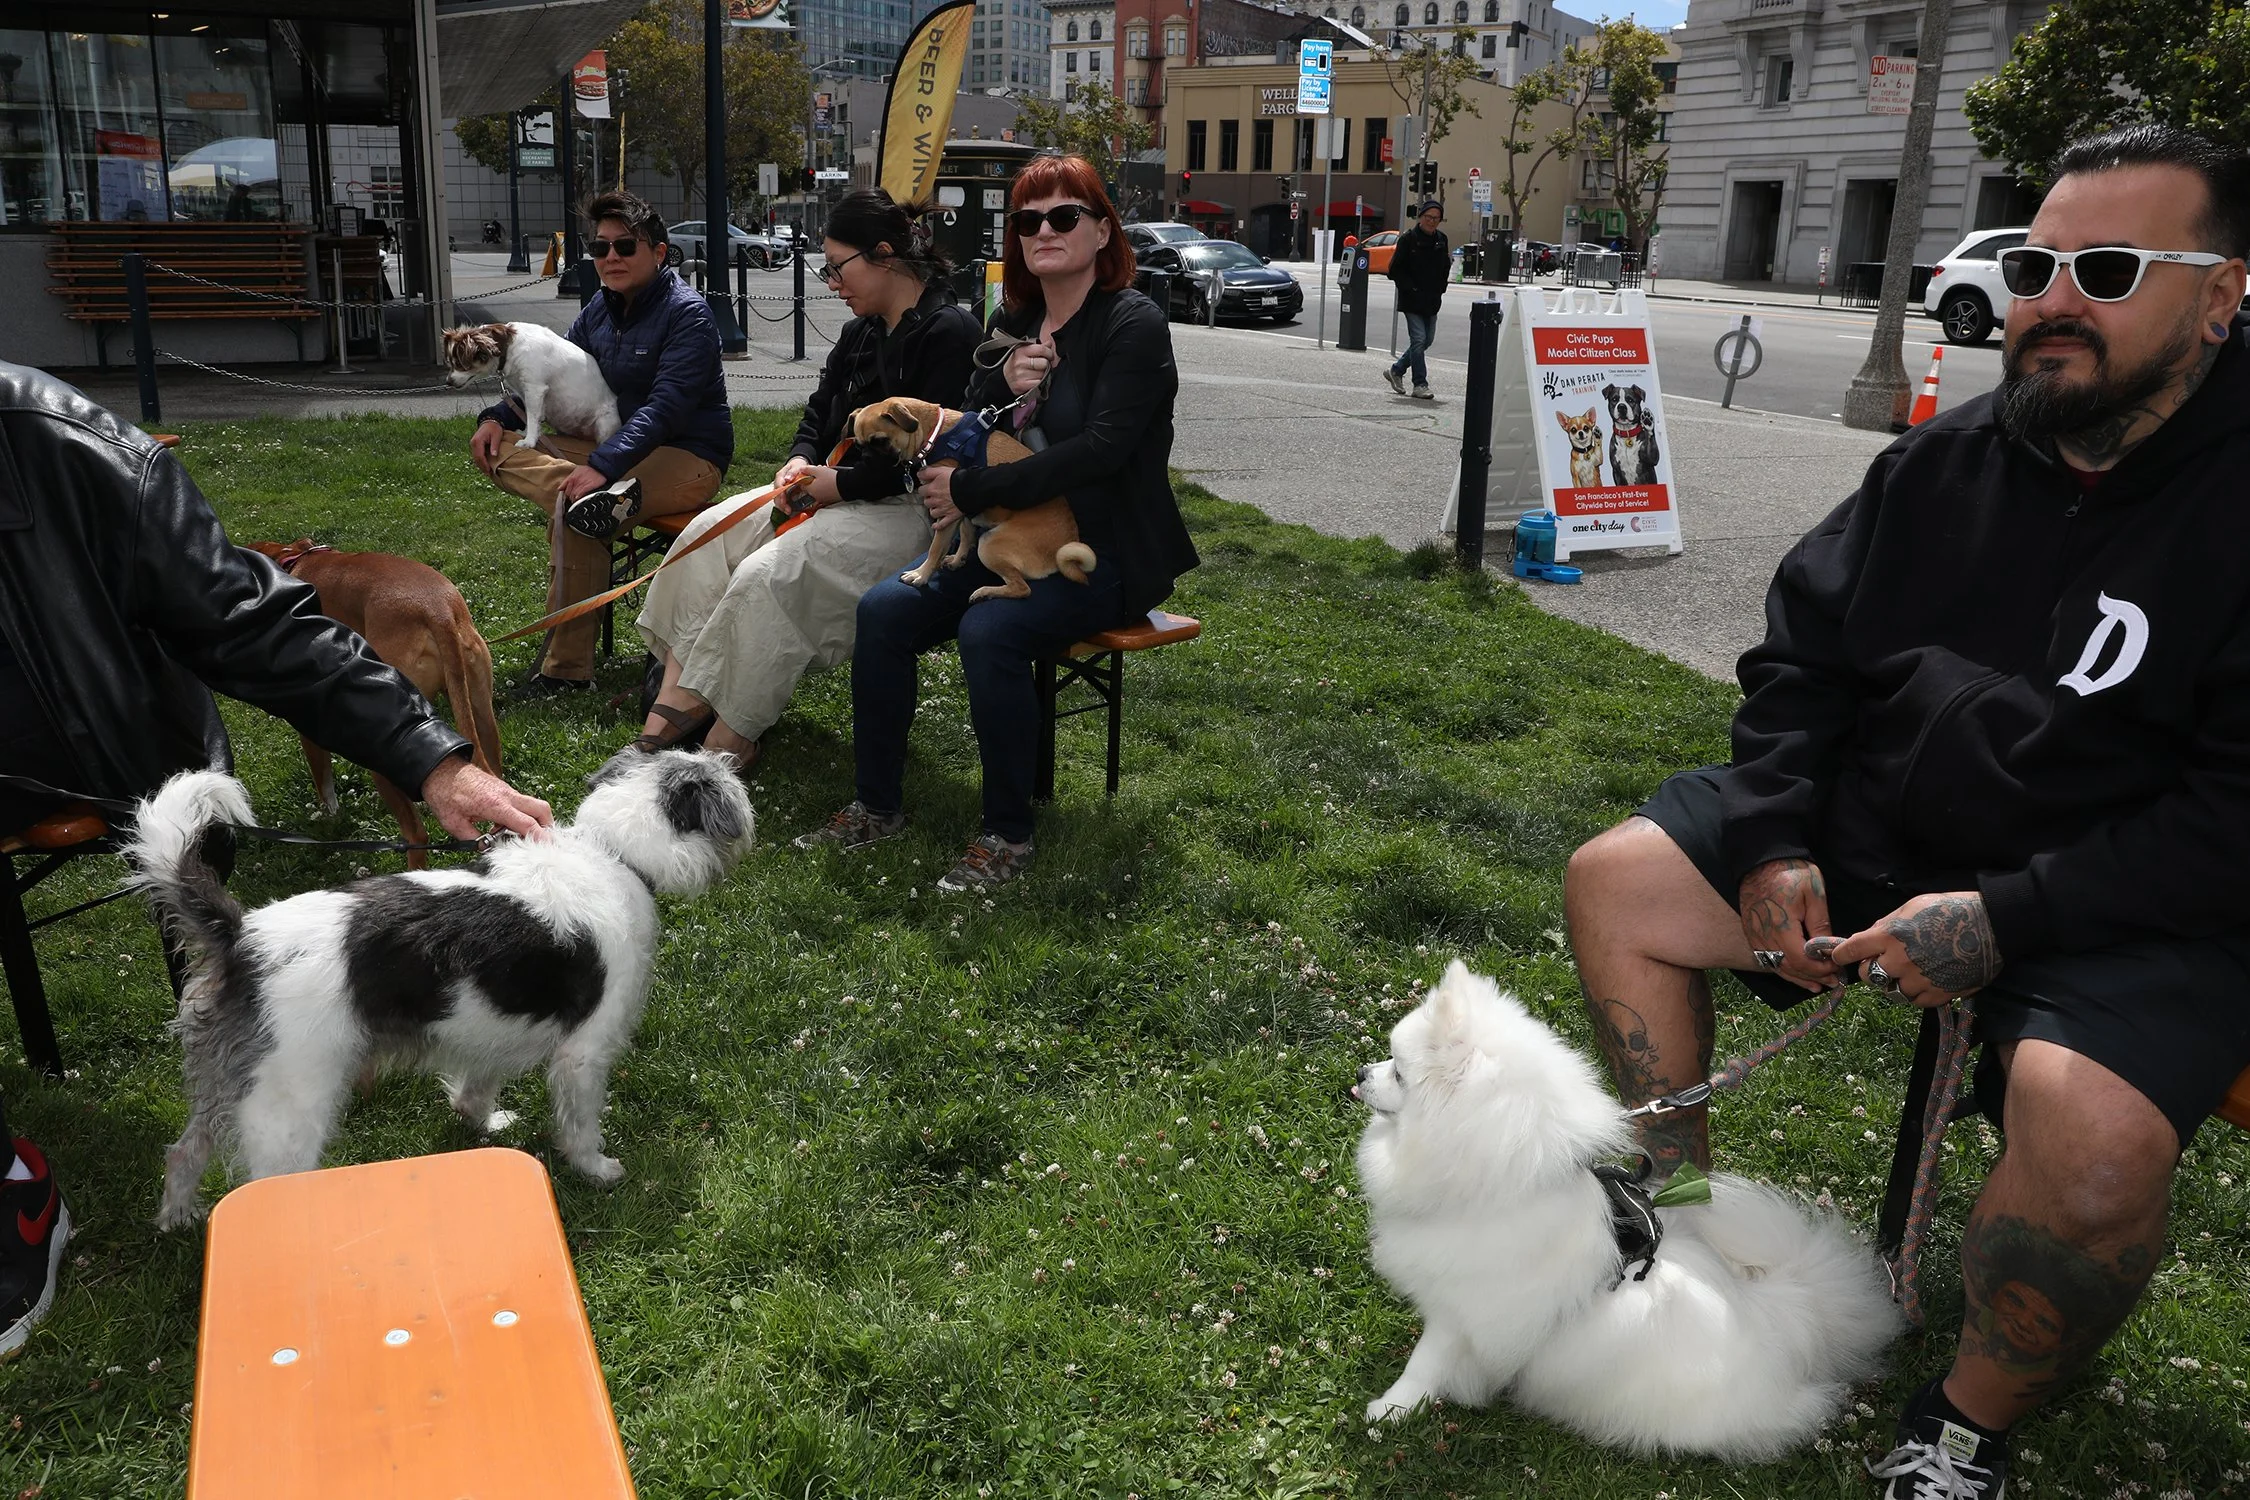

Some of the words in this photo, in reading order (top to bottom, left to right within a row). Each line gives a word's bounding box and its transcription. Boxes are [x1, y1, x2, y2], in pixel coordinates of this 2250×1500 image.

[1303, 43, 1315, 52] Pay
[1315, 44, 1330, 52] here
[917, 27, 944, 96] BEER
[1872, 58, 1886, 74] NO
[1886, 63, 1915, 75] PARKING
[1301, 78, 1312, 86] Pay
[1313, 78, 1322, 87] by
[1301, 84, 1323, 93] License
[1261, 88, 1299, 100] WELL
[1300, 90, 1316, 98] Plate
[915, 103, 933, 124] &
[1566, 333, 1590, 345] Civic
[1592, 333, 1615, 346] Pups
[1547, 348, 1578, 359] Model
[1579, 347, 1611, 359] Citizen
[1612, 347, 1637, 358] Class
[1560, 376, 1577, 389] DAN
[1578, 372, 1606, 386] PERATA
[1571, 385, 1597, 396] TRAINING
[1574, 493, 1587, 501] San
[1587, 492, 1621, 500] Francisco's
[1622, 490, 1649, 499] First-Ever
[1576, 502, 1604, 511] Citywide
[1604, 501, 1618, 510] Day
[1625, 499, 1650, 508] Service!
[1572, 525, 1590, 533] one
[1590, 520, 1608, 533] city
[1608, 520, 1626, 533] day
[2056, 590, 2149, 697] D
[1949, 1429, 1971, 1446] VANS
